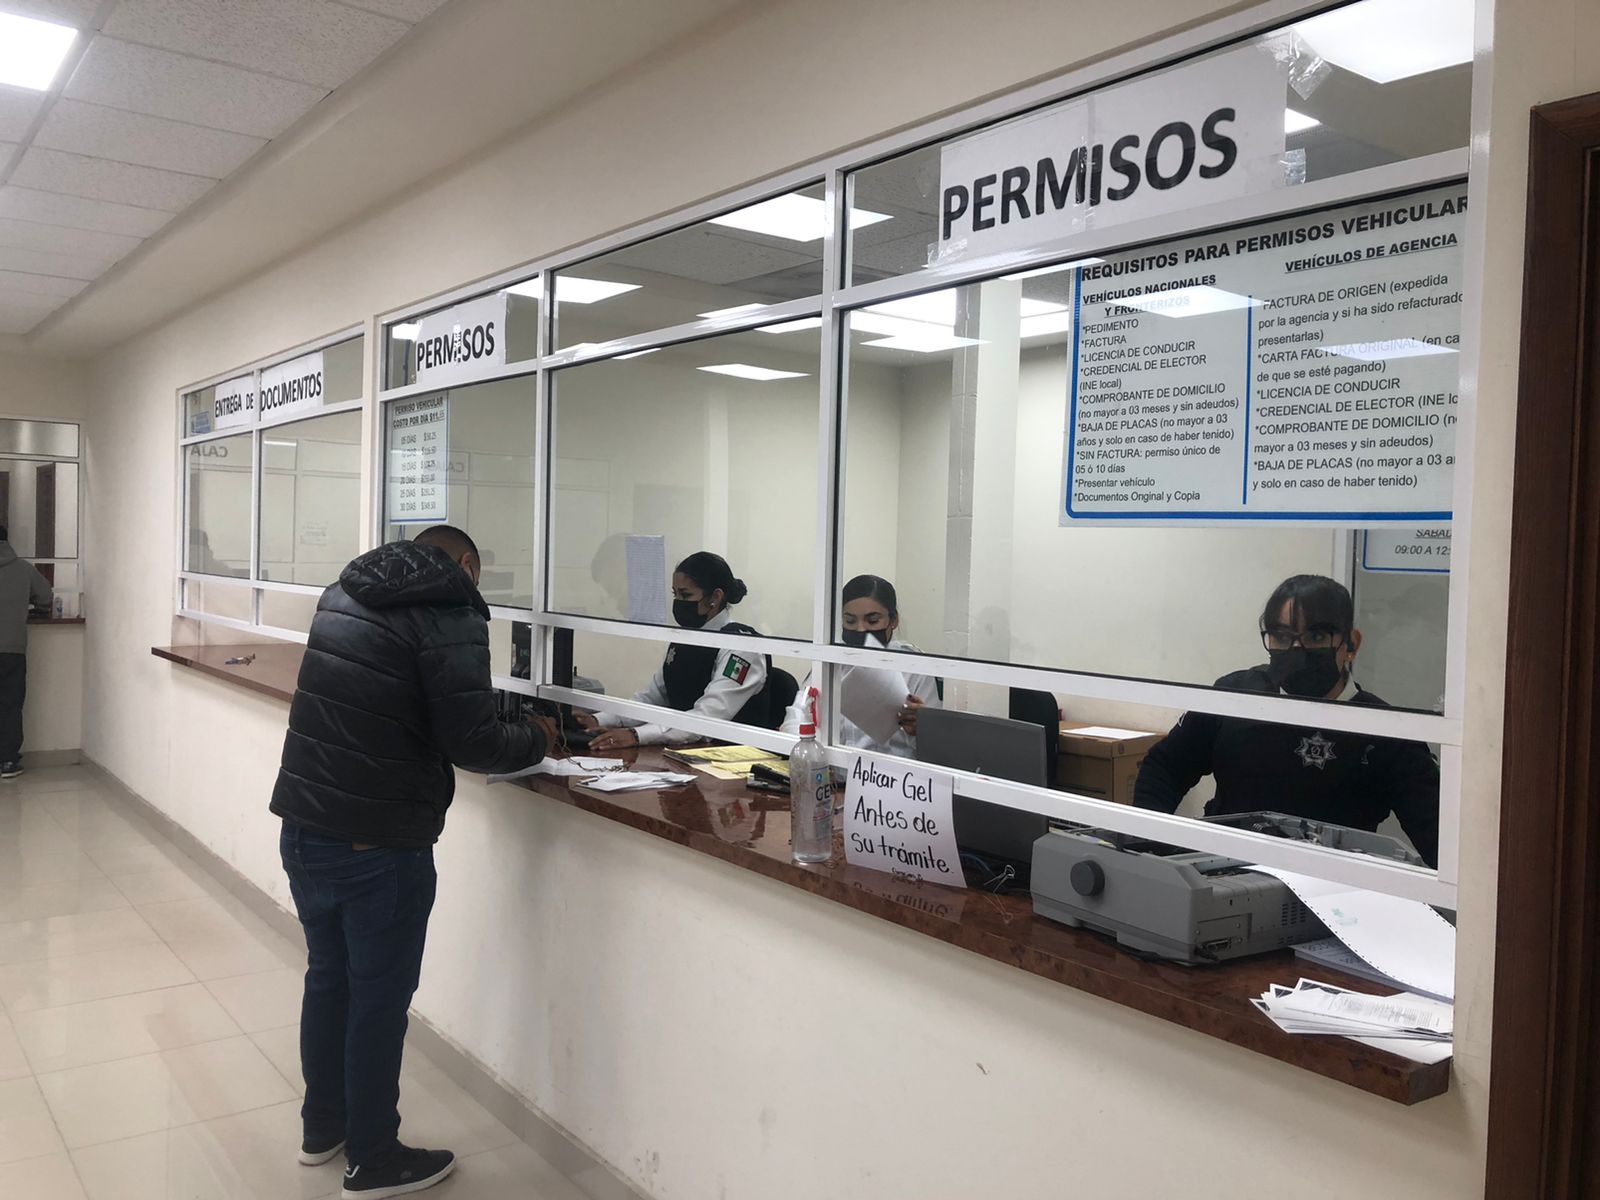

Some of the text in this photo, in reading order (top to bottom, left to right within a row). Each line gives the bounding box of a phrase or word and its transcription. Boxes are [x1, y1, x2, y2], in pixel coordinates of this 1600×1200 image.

[942, 107, 1238, 241] PERMISOS
[1081, 252, 1178, 281] REQUISITOS
[1184, 242, 1230, 263] PARA
[1235, 221, 1334, 254] PERMISOS
[1285, 233, 1458, 272] VEHÍCULOS DE AGENCIA
[1144, 275, 1216, 295] NACIONALES
[1317, 290, 1334, 302] DE
[1337, 283, 1386, 300] ORIGEN
[1390, 273, 1448, 295] (expedida
[1104, 308, 1112, 316] Y
[1258, 319, 1274, 330] por
[1277, 315, 1286, 326] la
[1288, 310, 1329, 326] agencia
[1332, 310, 1339, 321] y
[1341, 307, 1351, 317] si
[1354, 304, 1368, 316] ha
[1370, 301, 1394, 314] sido
[416, 321, 495, 372] PERMISOS
[1258, 330, 1324, 348] presentarlas)
[1127, 348, 1140, 357] DE
[1142, 341, 1195, 356] CONDUCIR
[1144, 360, 1157, 370] DE
[1160, 355, 1206, 369] ELECTOR
[1256, 360, 1386, 383] de que se esté pagando)
[1079, 379, 1122, 390] (INE local)
[1156, 388, 1170, 398] DE
[1172, 383, 1226, 397] DOMICILIO
[1314, 384, 1330, 395] DE
[1333, 378, 1400, 394] CONDUCIR
[215, 371, 322, 418] ENTREGA DE DOCUMENTOS
[1335, 401, 1352, 412] DE
[1355, 396, 1415, 411] ELECTOR
[1418, 394, 1445, 407] (INE
[1078, 408, 1091, 419] (no
[1093, 408, 1119, 419] mayor
[1128, 405, 1140, 414] 03
[1142, 405, 1170, 414] meses
[1172, 404, 1178, 414] y
[1180, 401, 1194, 411] sin
[1195, 398, 1239, 411] adeudos)
[1105, 421, 1118, 431] DE
[1120, 418, 1158, 430] PLACAS
[1160, 417, 1173, 429] (no
[1174, 418, 1204, 428] mayor
[1216, 414, 1228, 424] 03
[1352, 418, 1369, 430] DE
[1372, 414, 1440, 429] DOMICILIO
[1443, 412, 1458, 426] (n
[1076, 436, 1097, 446] años
[1098, 438, 1104, 447] y
[1105, 435, 1123, 445] solo
[1137, 435, 1158, 443] caso
[1160, 433, 1172, 442] de
[1174, 431, 1200, 441] haber
[1202, 430, 1234, 442] tenido)
[1254, 435, 1434, 455] mayor a 03 meses y sin adeudos)
[1096, 448, 1142, 460] FACTURA:
[1144, 447, 1180, 460] permiso
[1182, 446, 1207, 456] único
[1208, 445, 1221, 455] de
[1075, 464, 1125, 474] 05 ó 10 días
[1288, 459, 1303, 470] DE
[1306, 457, 1352, 469] PLACAS
[1355, 457, 1374, 469] (no
[1376, 458, 1412, 469] mayor
[1415, 458, 1423, 466] a
[1426, 454, 1442, 465] 03
[1252, 475, 1417, 492] y solo en caso de haber tenido)
[1166, 494, 1172, 502] y
[1174, 491, 1200, 502] Copia
[1394, 545, 1423, 554] 09:00
[1424, 546, 1432, 554] A
[852, 756, 932, 803] Aplicar Gel
[854, 796, 939, 836] Antes de
